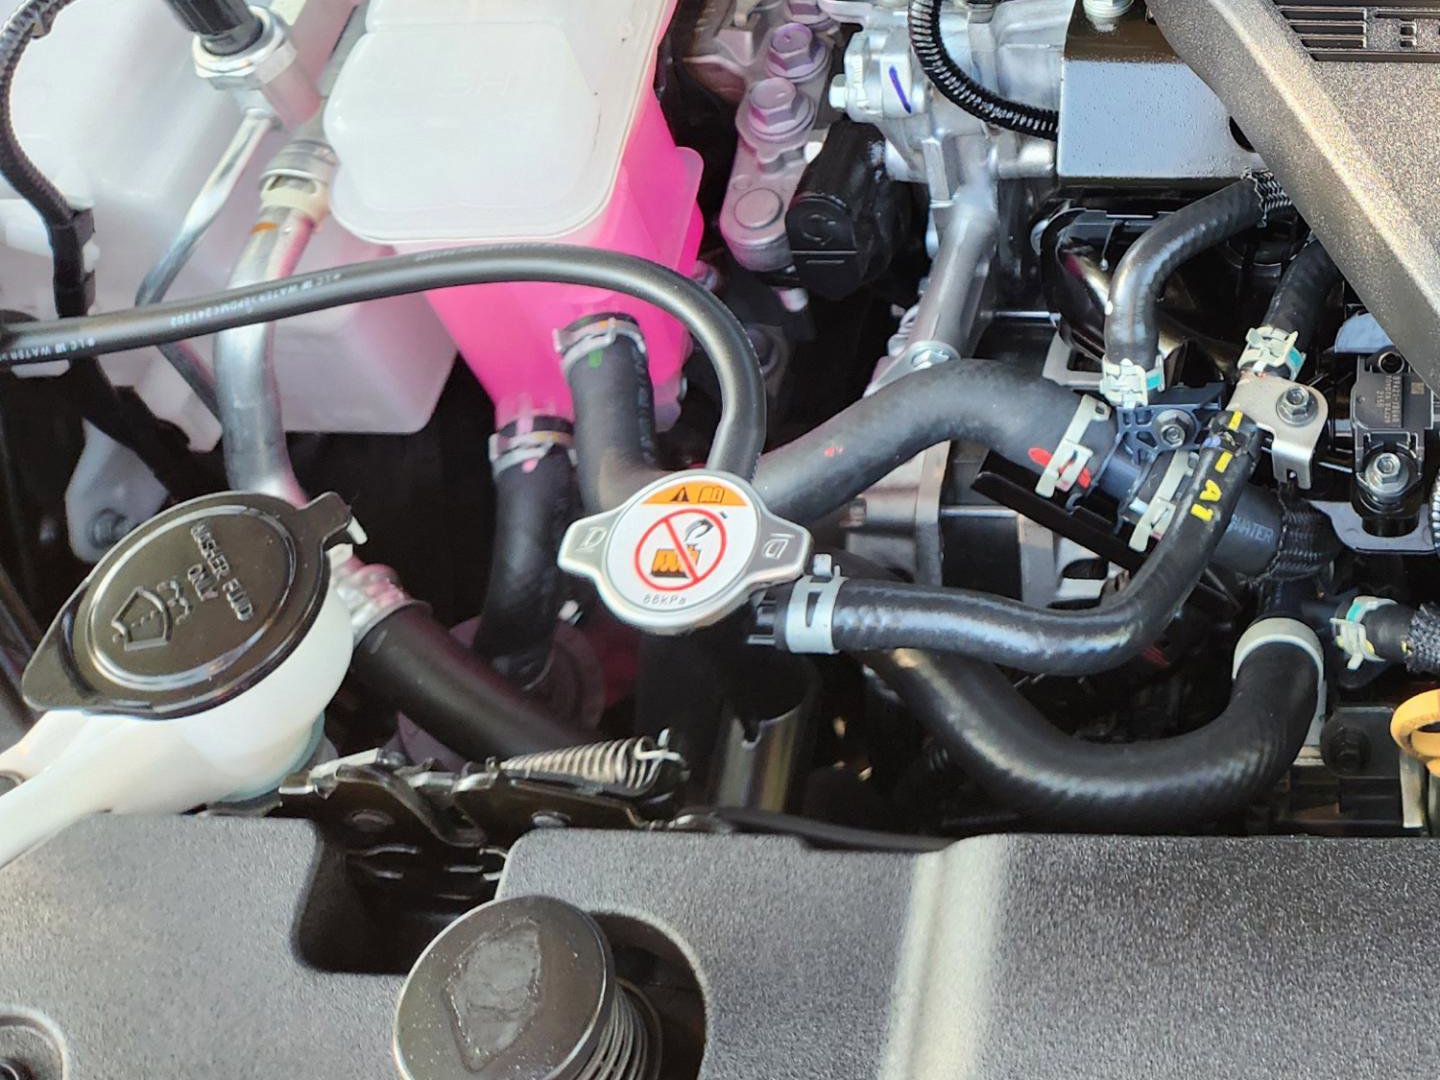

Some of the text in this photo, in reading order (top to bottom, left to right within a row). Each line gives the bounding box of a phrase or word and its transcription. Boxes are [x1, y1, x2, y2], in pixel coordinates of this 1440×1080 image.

[1191, 480, 1222, 521] A1
[186, 562, 220, 601] ONLY
[189, 520, 256, 624] WASHER FLUID
